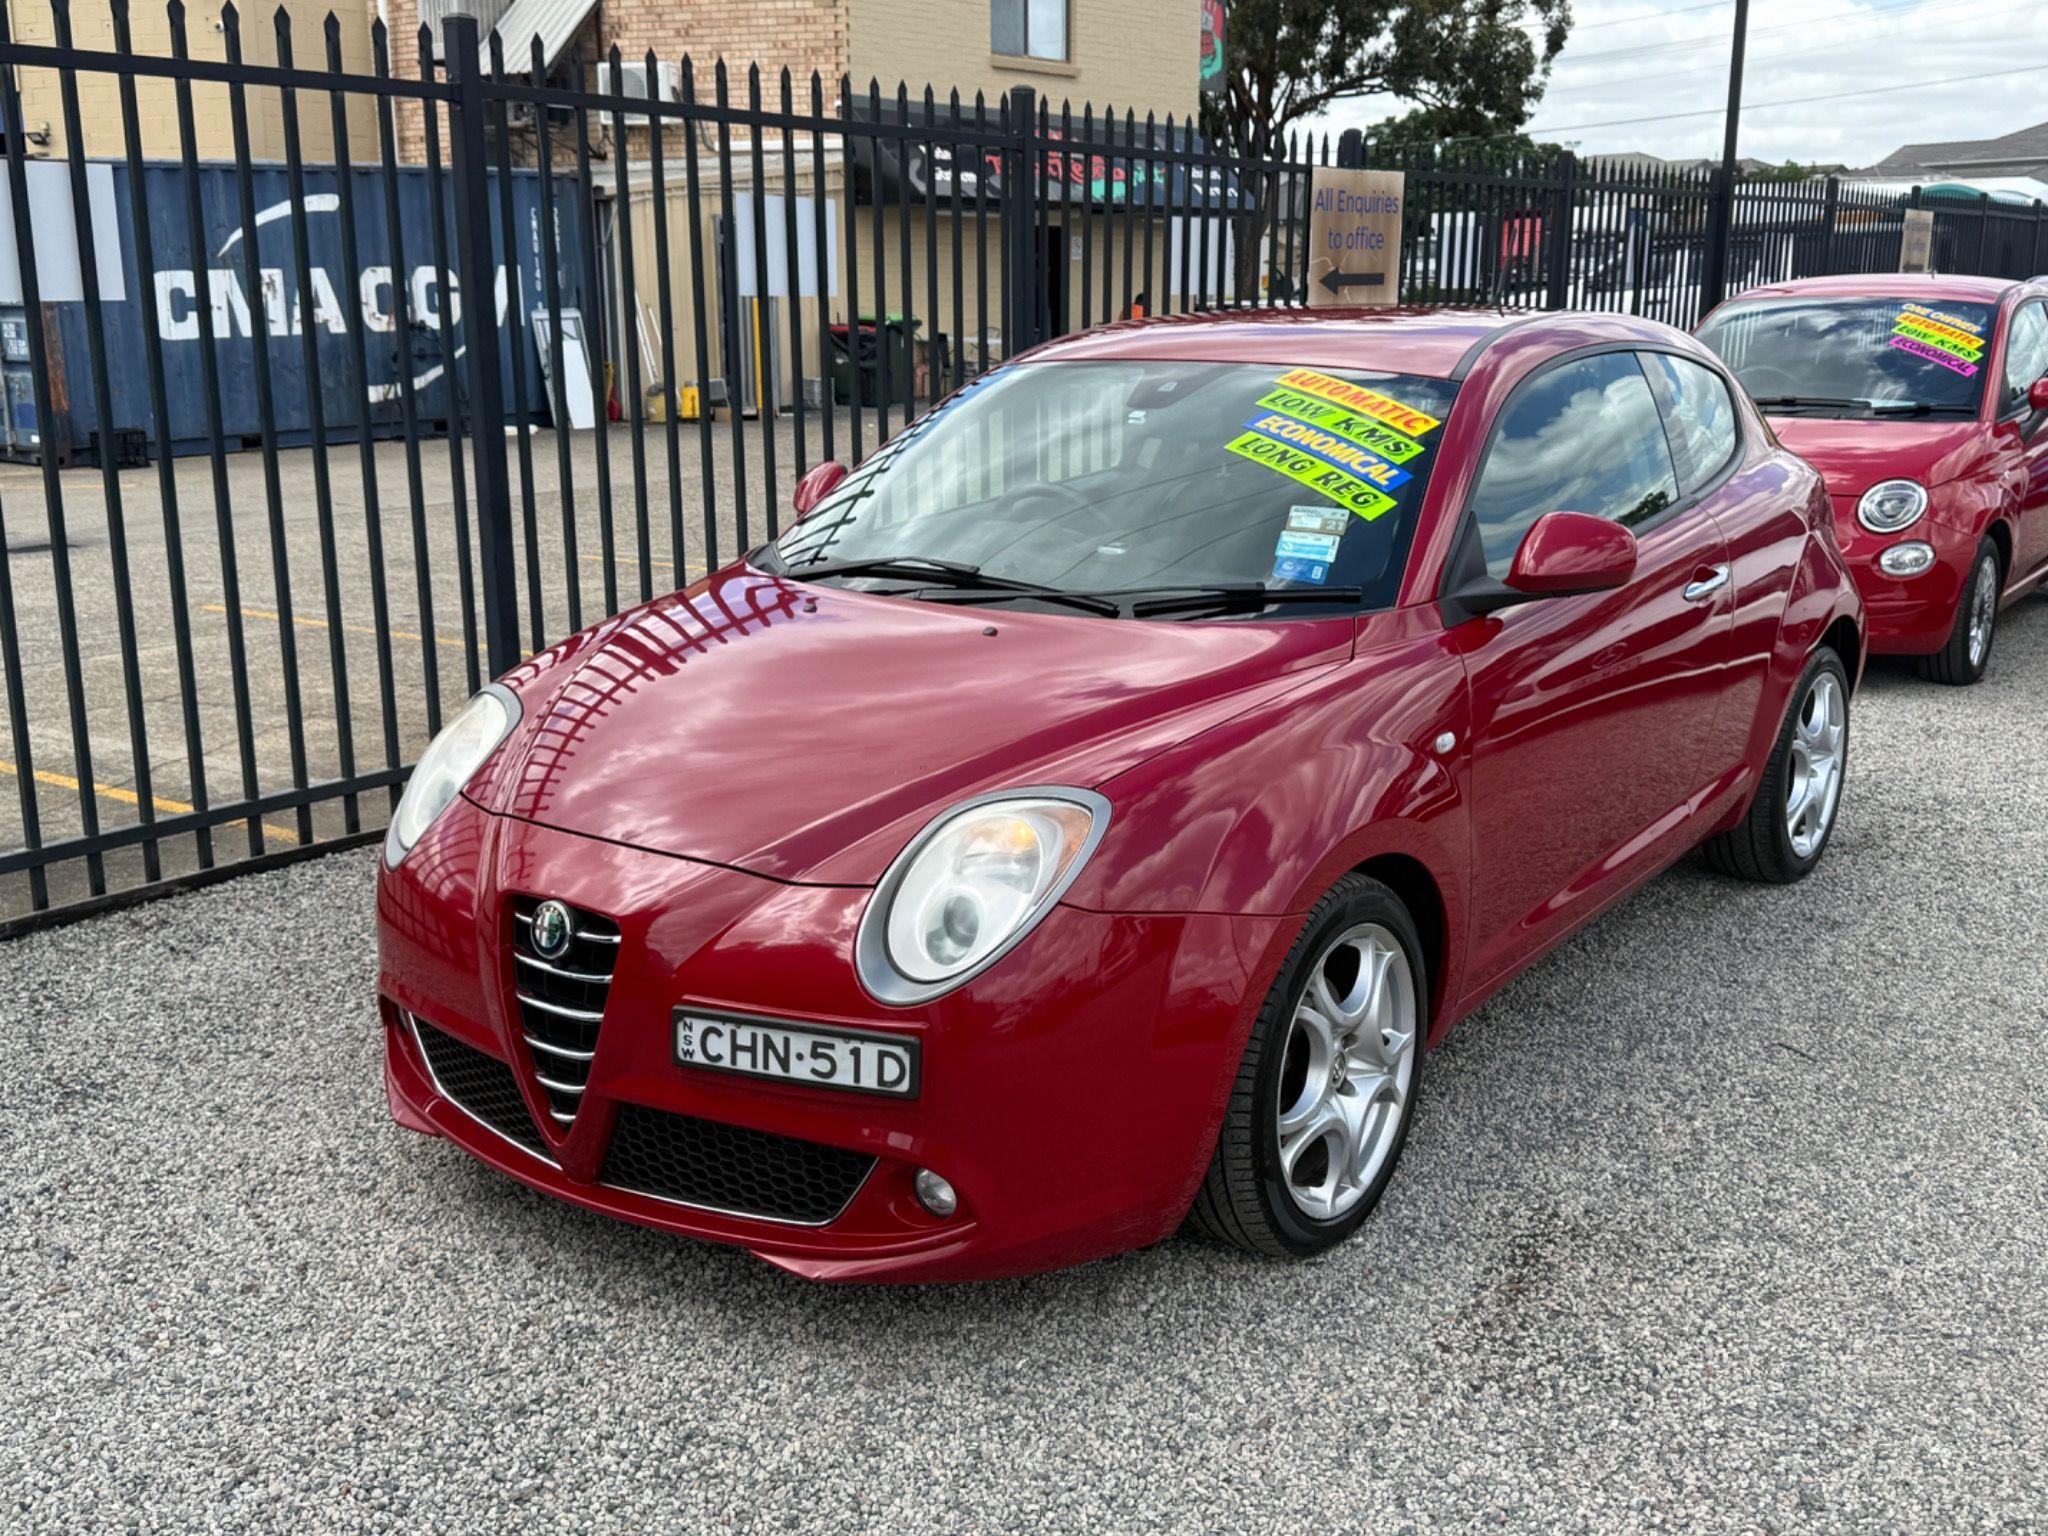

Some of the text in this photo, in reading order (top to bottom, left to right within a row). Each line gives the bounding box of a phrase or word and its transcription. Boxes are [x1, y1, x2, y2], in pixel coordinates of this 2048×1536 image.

[1314, 187, 1399, 217] All Enquiries
[1327, 226, 1385, 250] to office
[1267, 392, 1414, 457] LOW KMS
[1284, 371, 1431, 431] AUTOMATIC
[1239, 437, 1382, 508] LONG REG
[1253, 414, 1400, 486] ECONOMICAL
[682, 1020, 694, 1059] NSW
